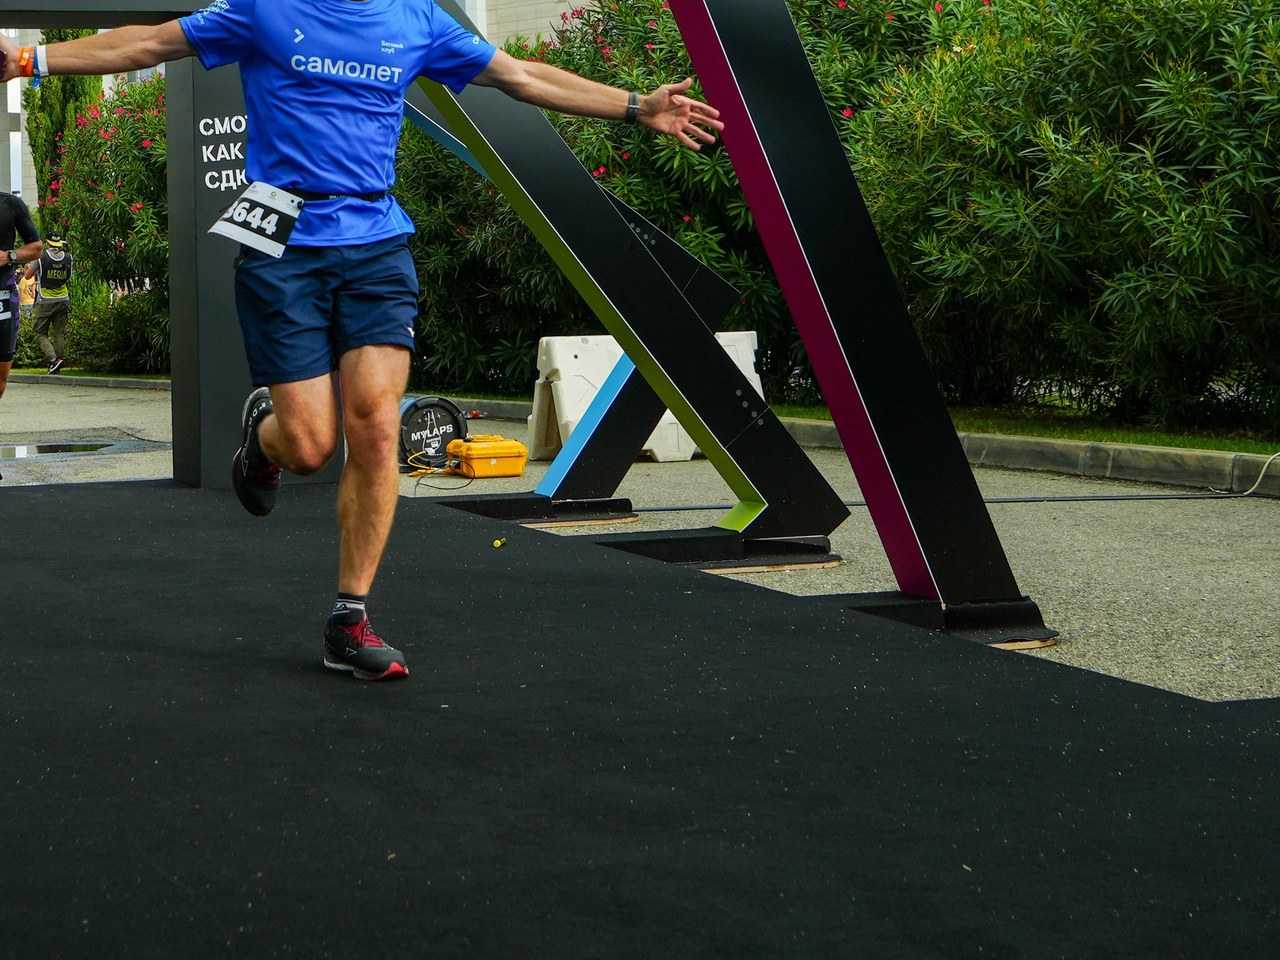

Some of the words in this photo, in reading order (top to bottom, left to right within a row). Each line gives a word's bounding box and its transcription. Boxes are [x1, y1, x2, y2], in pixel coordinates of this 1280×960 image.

[291, 54, 403, 83] самолет
[199, 114, 248, 136] СМО
[202, 142, 244, 162] КАК
[411, 424, 453, 441] MYLAPS
